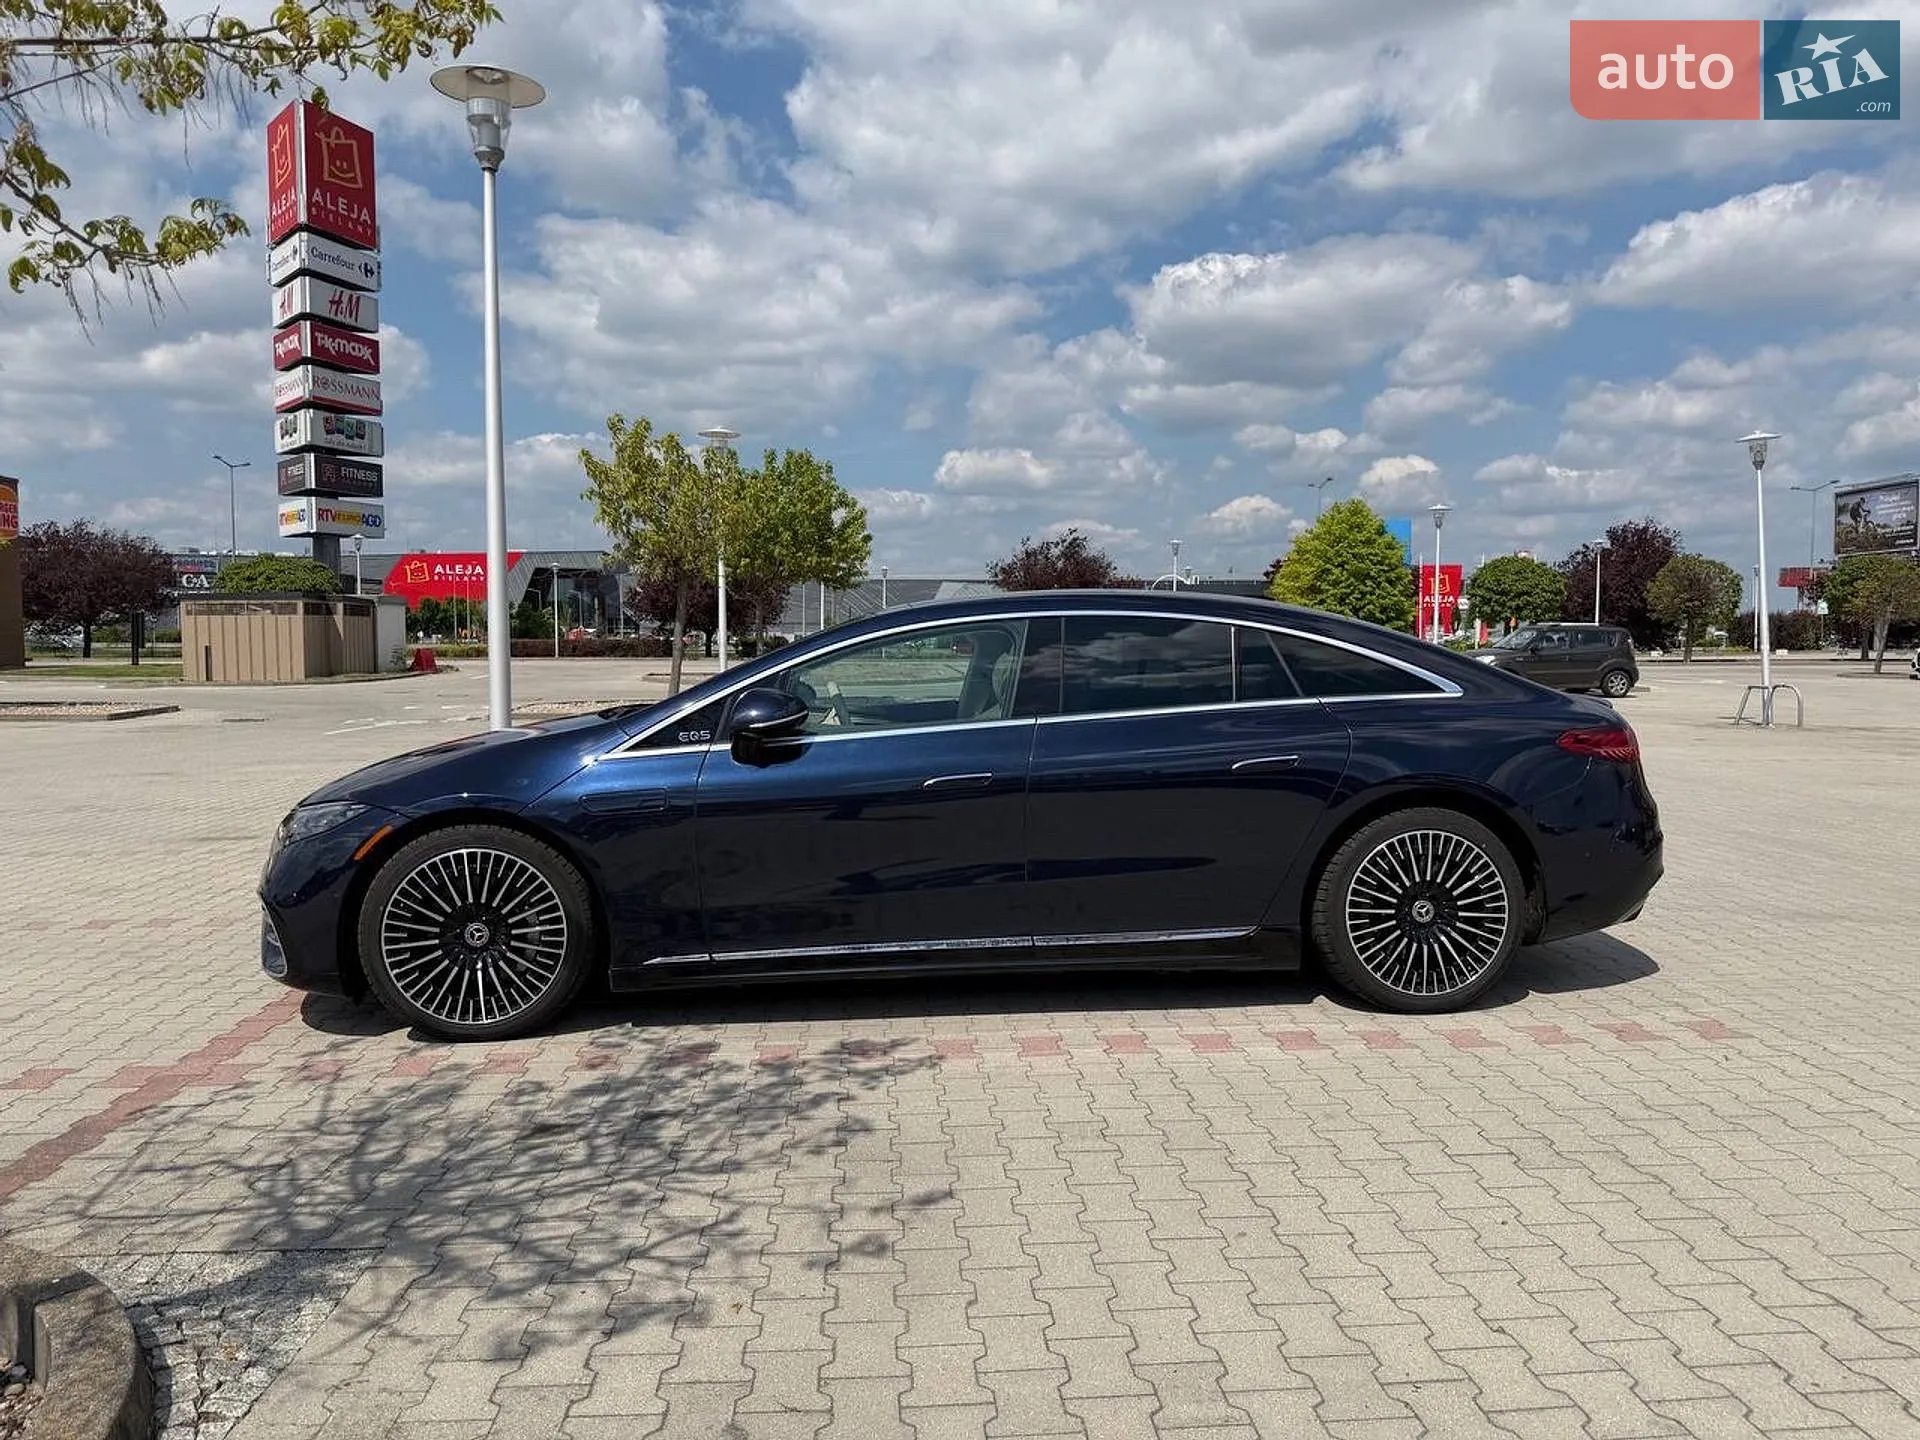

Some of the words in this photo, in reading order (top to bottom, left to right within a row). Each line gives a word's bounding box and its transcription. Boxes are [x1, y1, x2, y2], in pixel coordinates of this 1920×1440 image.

[272, 185, 297, 219] ALEJA
[312, 187, 371, 224] ALEJA
[311, 246, 355, 270] Carrefour
[329, 288, 361, 323] H&M
[312, 375, 381, 400] ROSSMANN
[341, 467, 378, 482] FITNESS
[317, 508, 336, 523] RTV
[434, 564, 485, 575] ALEJA
[182, 573, 210, 588] C&A
[678, 730, 711, 742] EQS
